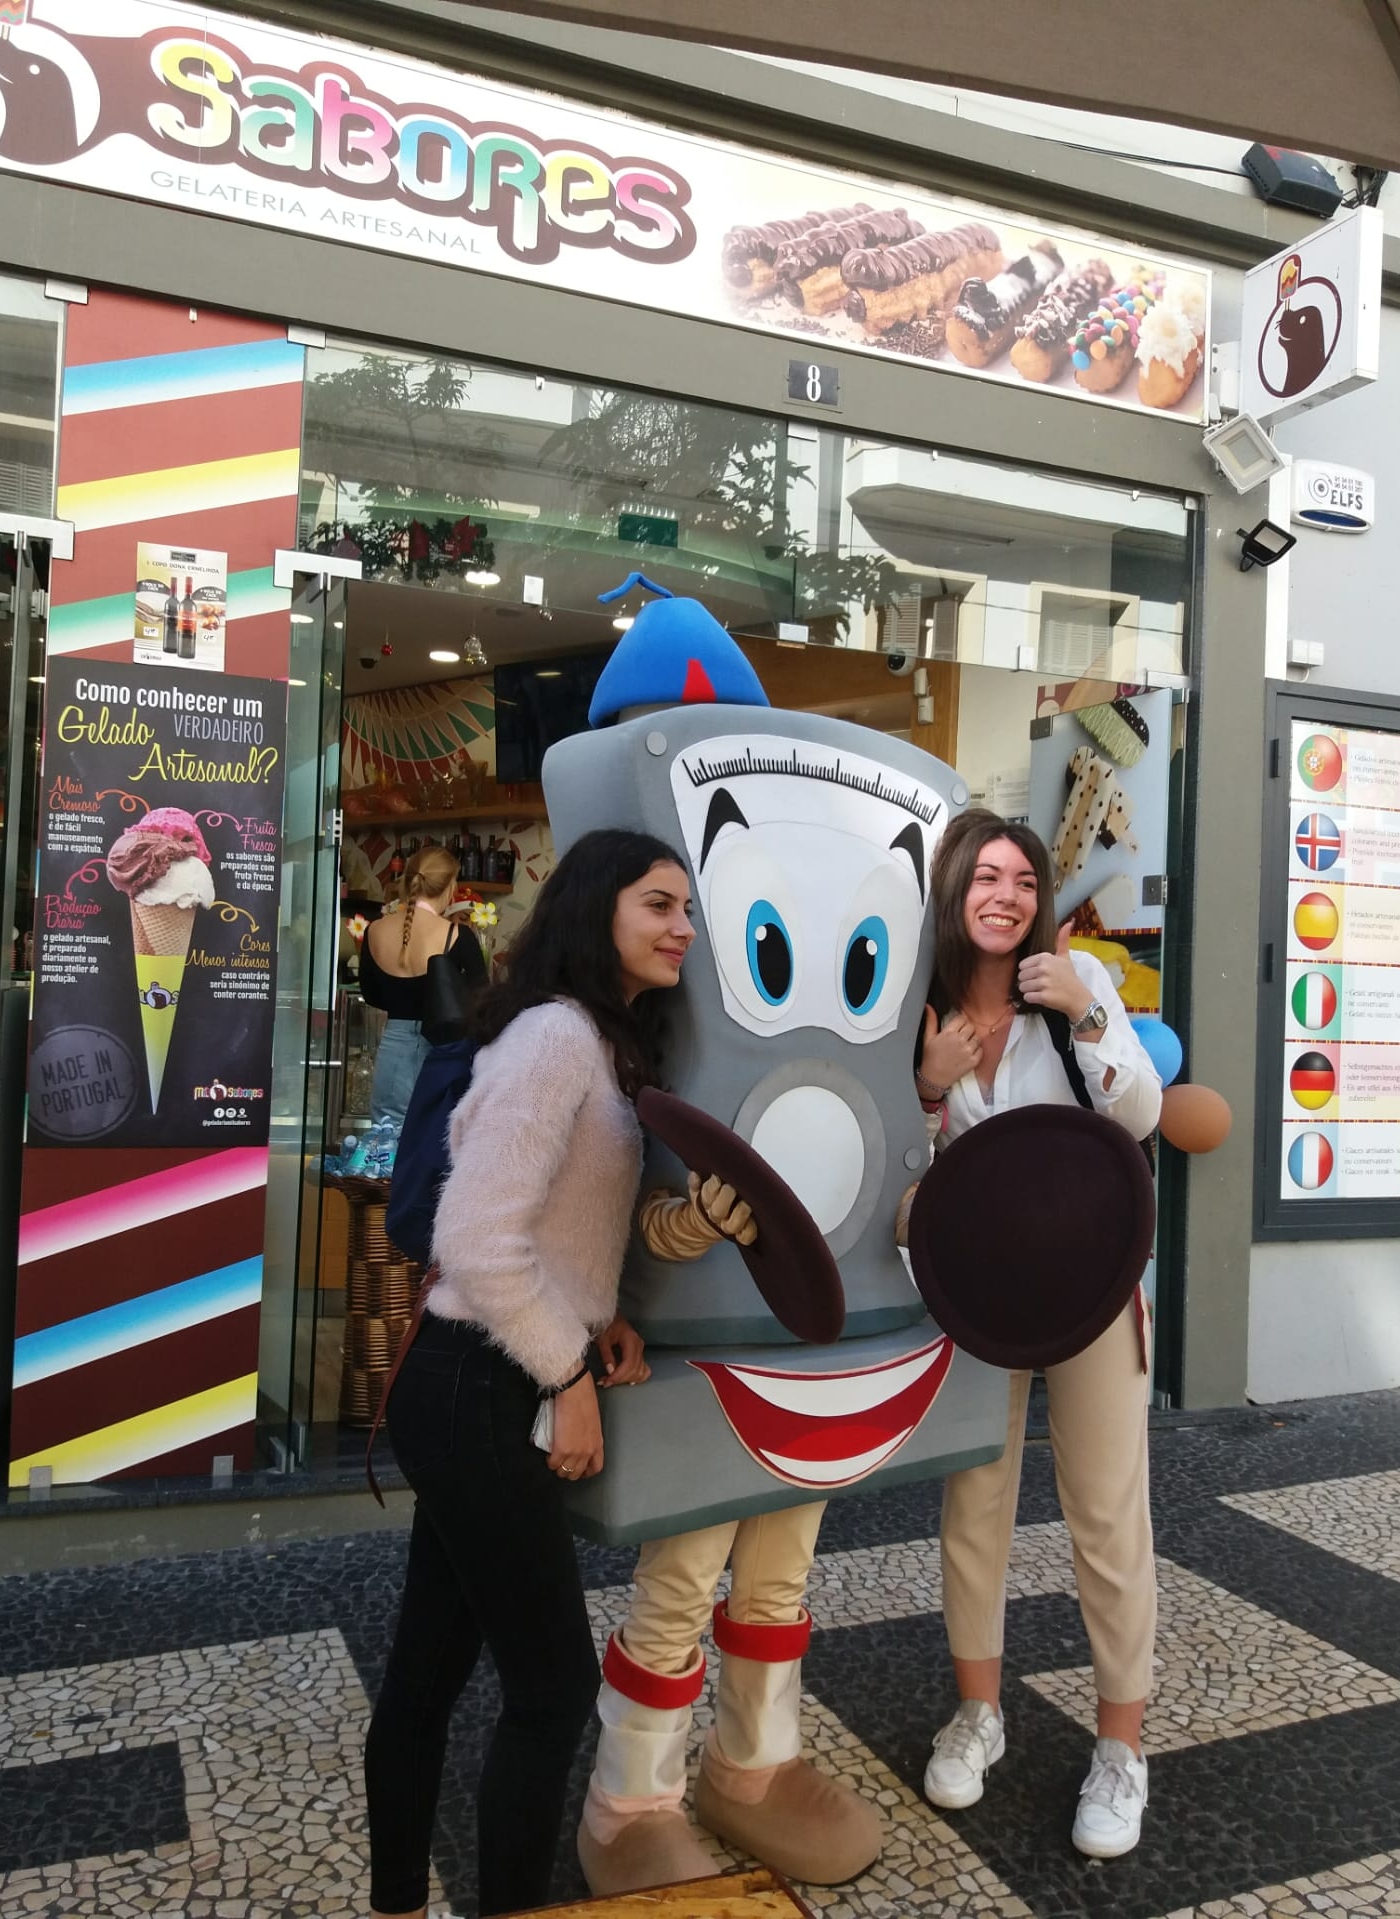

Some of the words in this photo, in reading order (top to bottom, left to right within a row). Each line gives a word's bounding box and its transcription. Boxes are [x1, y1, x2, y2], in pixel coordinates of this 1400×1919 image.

[150, 170, 308, 218] GELATERIA
[319, 207, 482, 255] ARTESANAL
[806, 364, 822, 402] 8
[76, 678, 131, 705] Como
[136, 686, 228, 715] conhecer
[233, 697, 263, 719] um
[58, 705, 155, 746] Gelado
[173, 713, 265, 746] VERDADEIRO
[128, 742, 279, 784] Artesanal?
[48, 775, 84, 795] Mais
[49, 791, 101, 813] Cremoso
[55, 812, 80, 823] gelado
[54, 822, 64, 831] de
[65, 822, 81, 832] fácil
[243, 817, 277, 836] Fruta
[48, 833, 103, 844] manuseamento
[240, 833, 277, 852] Fresca
[47, 843, 63, 852] com
[64, 844, 69, 852] a
[226, 851, 234, 860] os
[236, 852, 262, 862] sabores
[263, 852, 275, 863] são
[220, 861, 259, 871] preparados
[260, 864, 275, 872] com
[234, 871, 252, 880] fruta
[253, 872, 275, 882] fresca
[242, 881, 251, 890] da
[44, 894, 102, 918] Produção
[43, 933, 48, 941] o
[50, 932, 74, 943] gelado
[240, 933, 271, 952] Cores
[49, 944, 87, 953] preparado
[42, 952, 87, 963] diariamente
[88, 955, 98, 964] no
[184, 949, 226, 968] Menos
[230, 951, 270, 969] intensas
[42, 964, 63, 972] nosso
[64, 963, 88, 973] atelier
[89, 965, 99, 974] de
[221, 971, 237, 980] caso
[238, 971, 270, 981] contrário
[209, 980, 228, 989] seria
[261, 981, 270, 990] de
[213, 990, 237, 999] conter
[41, 1054, 89, 1088] MADE
[95, 1048, 112, 1075] IN
[41, 1077, 126, 1117] PORTUGAL
